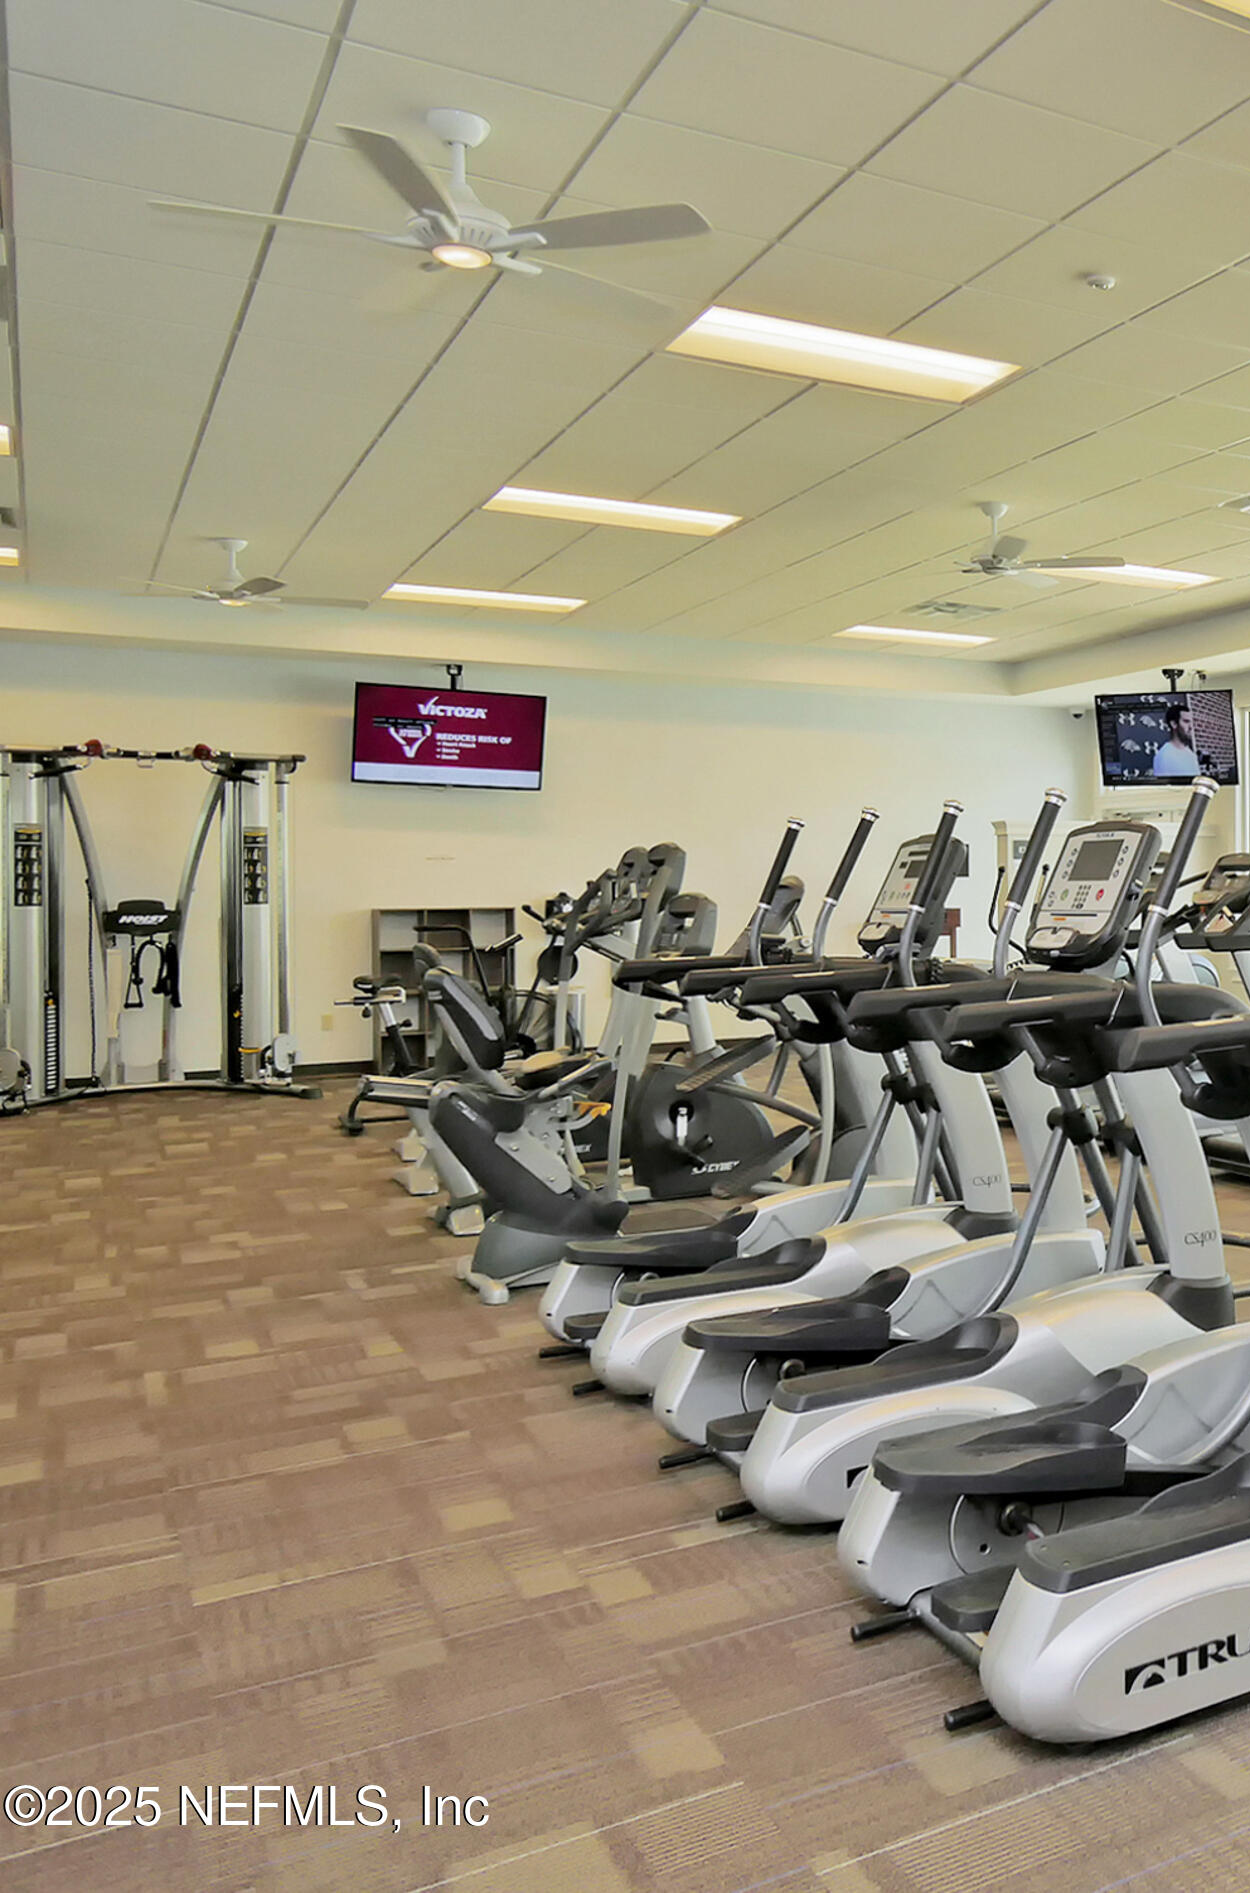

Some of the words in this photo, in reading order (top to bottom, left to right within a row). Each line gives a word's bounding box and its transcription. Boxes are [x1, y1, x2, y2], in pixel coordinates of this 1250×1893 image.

[478, 735, 499, 744] RISK
[500, 736, 512, 745] OF
[1184, 1230, 1217, 1247] CS400
